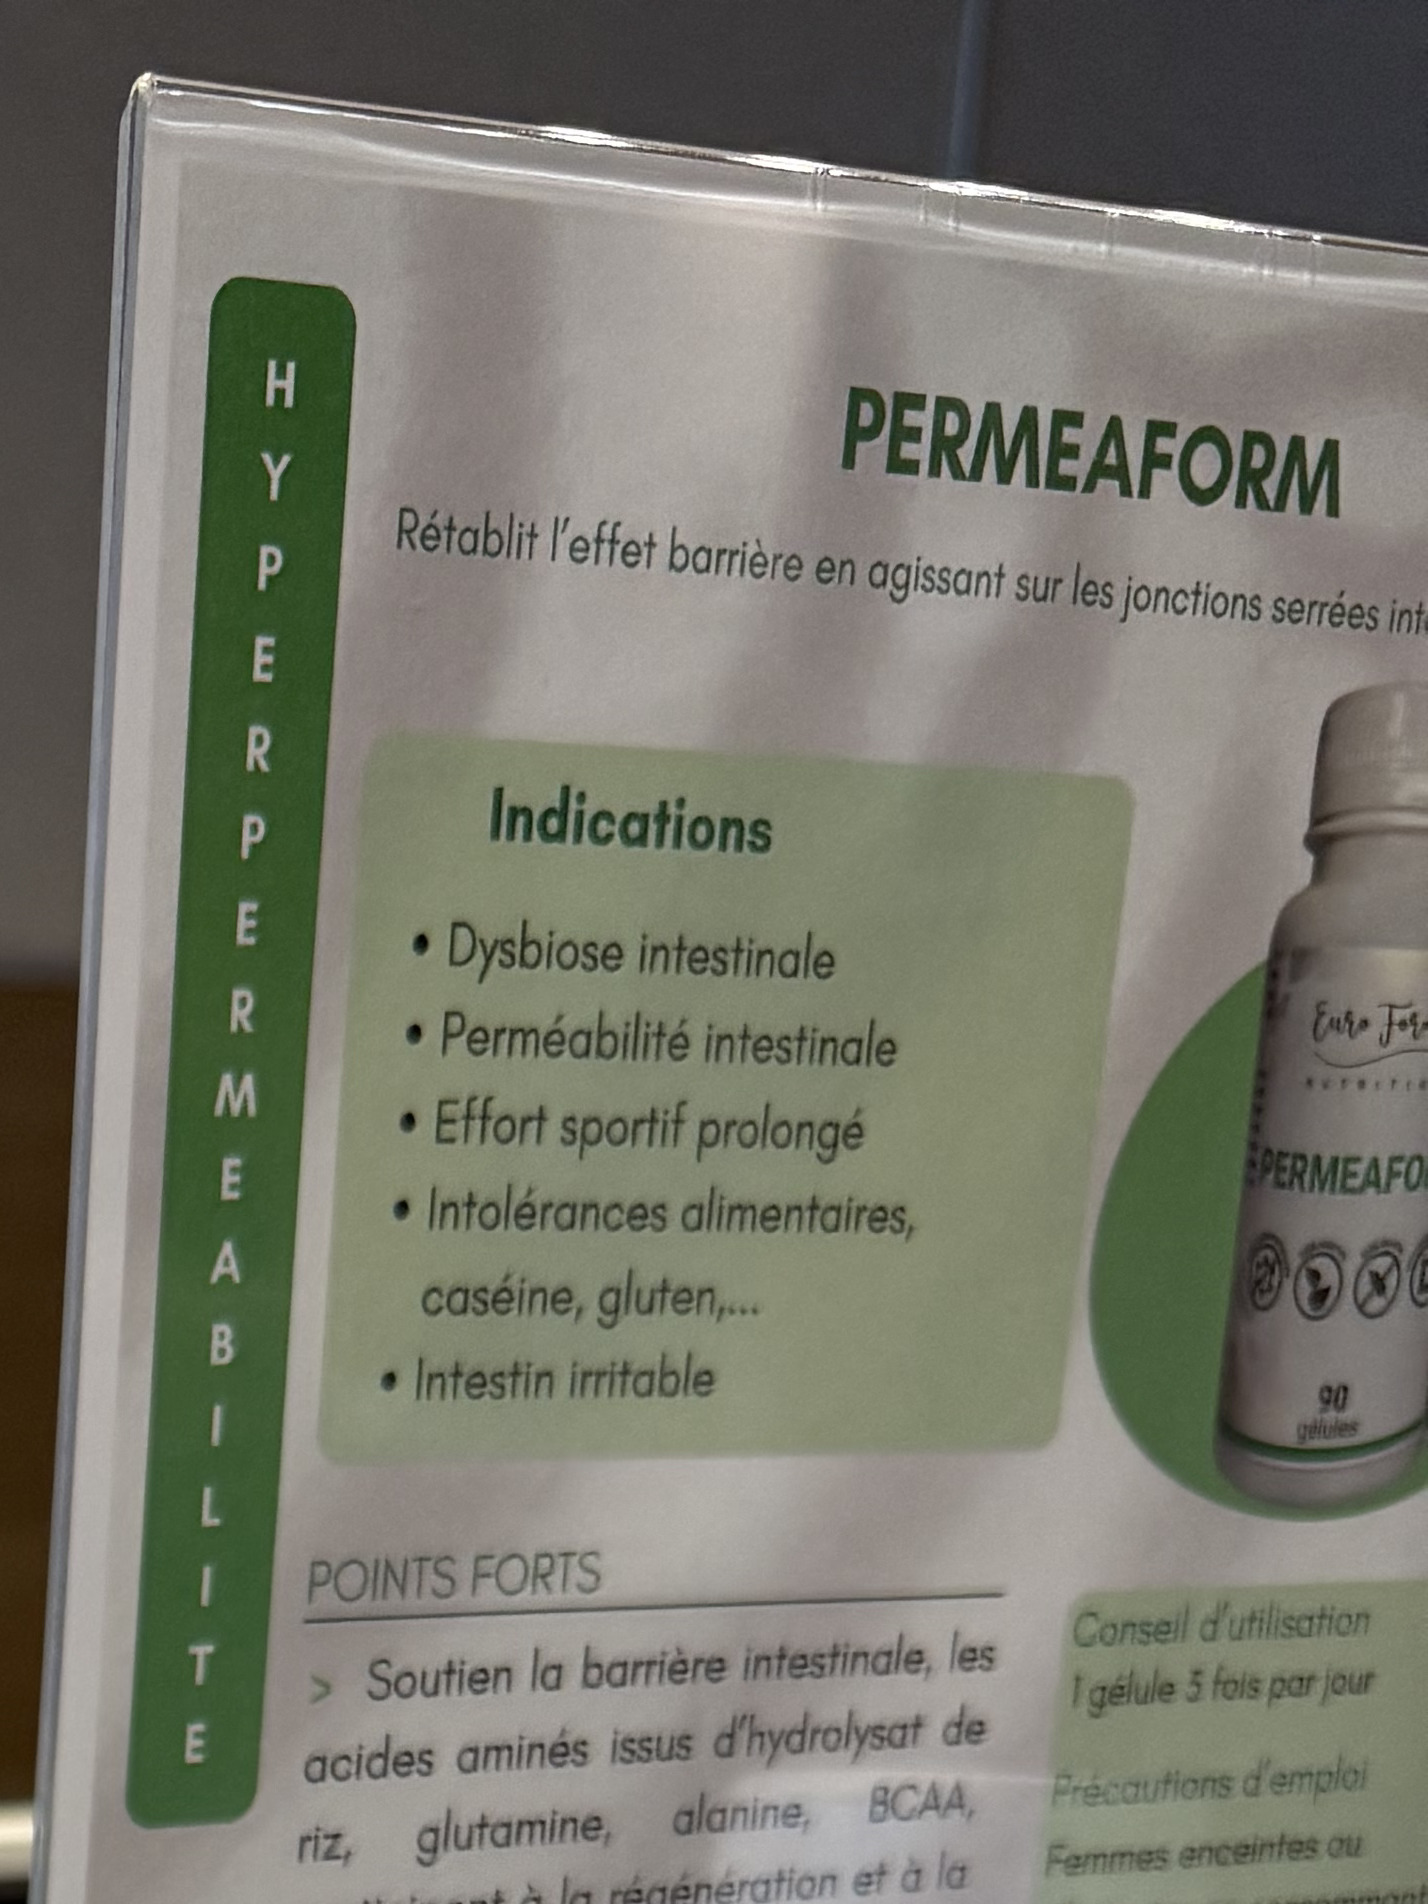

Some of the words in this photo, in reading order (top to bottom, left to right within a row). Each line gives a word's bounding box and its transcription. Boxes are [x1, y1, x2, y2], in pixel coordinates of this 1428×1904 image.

[842, 386, 1339, 518] PERMEAFORM
[396, 506, 539, 561] Rétablit
[551, 516, 657, 569] l'effet
[668, 525, 803, 582] barrière
[815, 555, 856, 586] en
[868, 556, 1006, 604] agissant
[1015, 573, 1064, 603] sur
[1072, 562, 1114, 609] les
[1118, 576, 1262, 624] jonctions
[1271, 590, 1379, 632] serrées
[490, 784, 772, 853] Indications
[449, 919, 624, 984] Dysbiose
[639, 931, 835, 980] intestinale
[183, 359, 296, 1765] HYPERPERMEABILITE
[442, 1009, 690, 1062] Perméabilité
[705, 1018, 898, 1067] intestinale
[435, 1094, 548, 1146] Effort
[560, 1100, 688, 1161] sportif
[696, 1102, 865, 1165] prolongé
[429, 1183, 667, 1233] Intolérances
[681, 1185, 915, 1242] alimentaires,
[421, 1273, 584, 1324] caséine,
[416, 1356, 554, 1401] Intestin
[569, 1351, 716, 1398] irritable
[308, 1555, 456, 1604] POINTS
[471, 1550, 602, 1597] FORTS
[367, 1658, 513, 1701] Soutien
[531, 1646, 564, 1692] la
[581, 1645, 728, 1689] barrière
[743, 1632, 933, 1681] intestinale,
[950, 1630, 997, 1673] les
